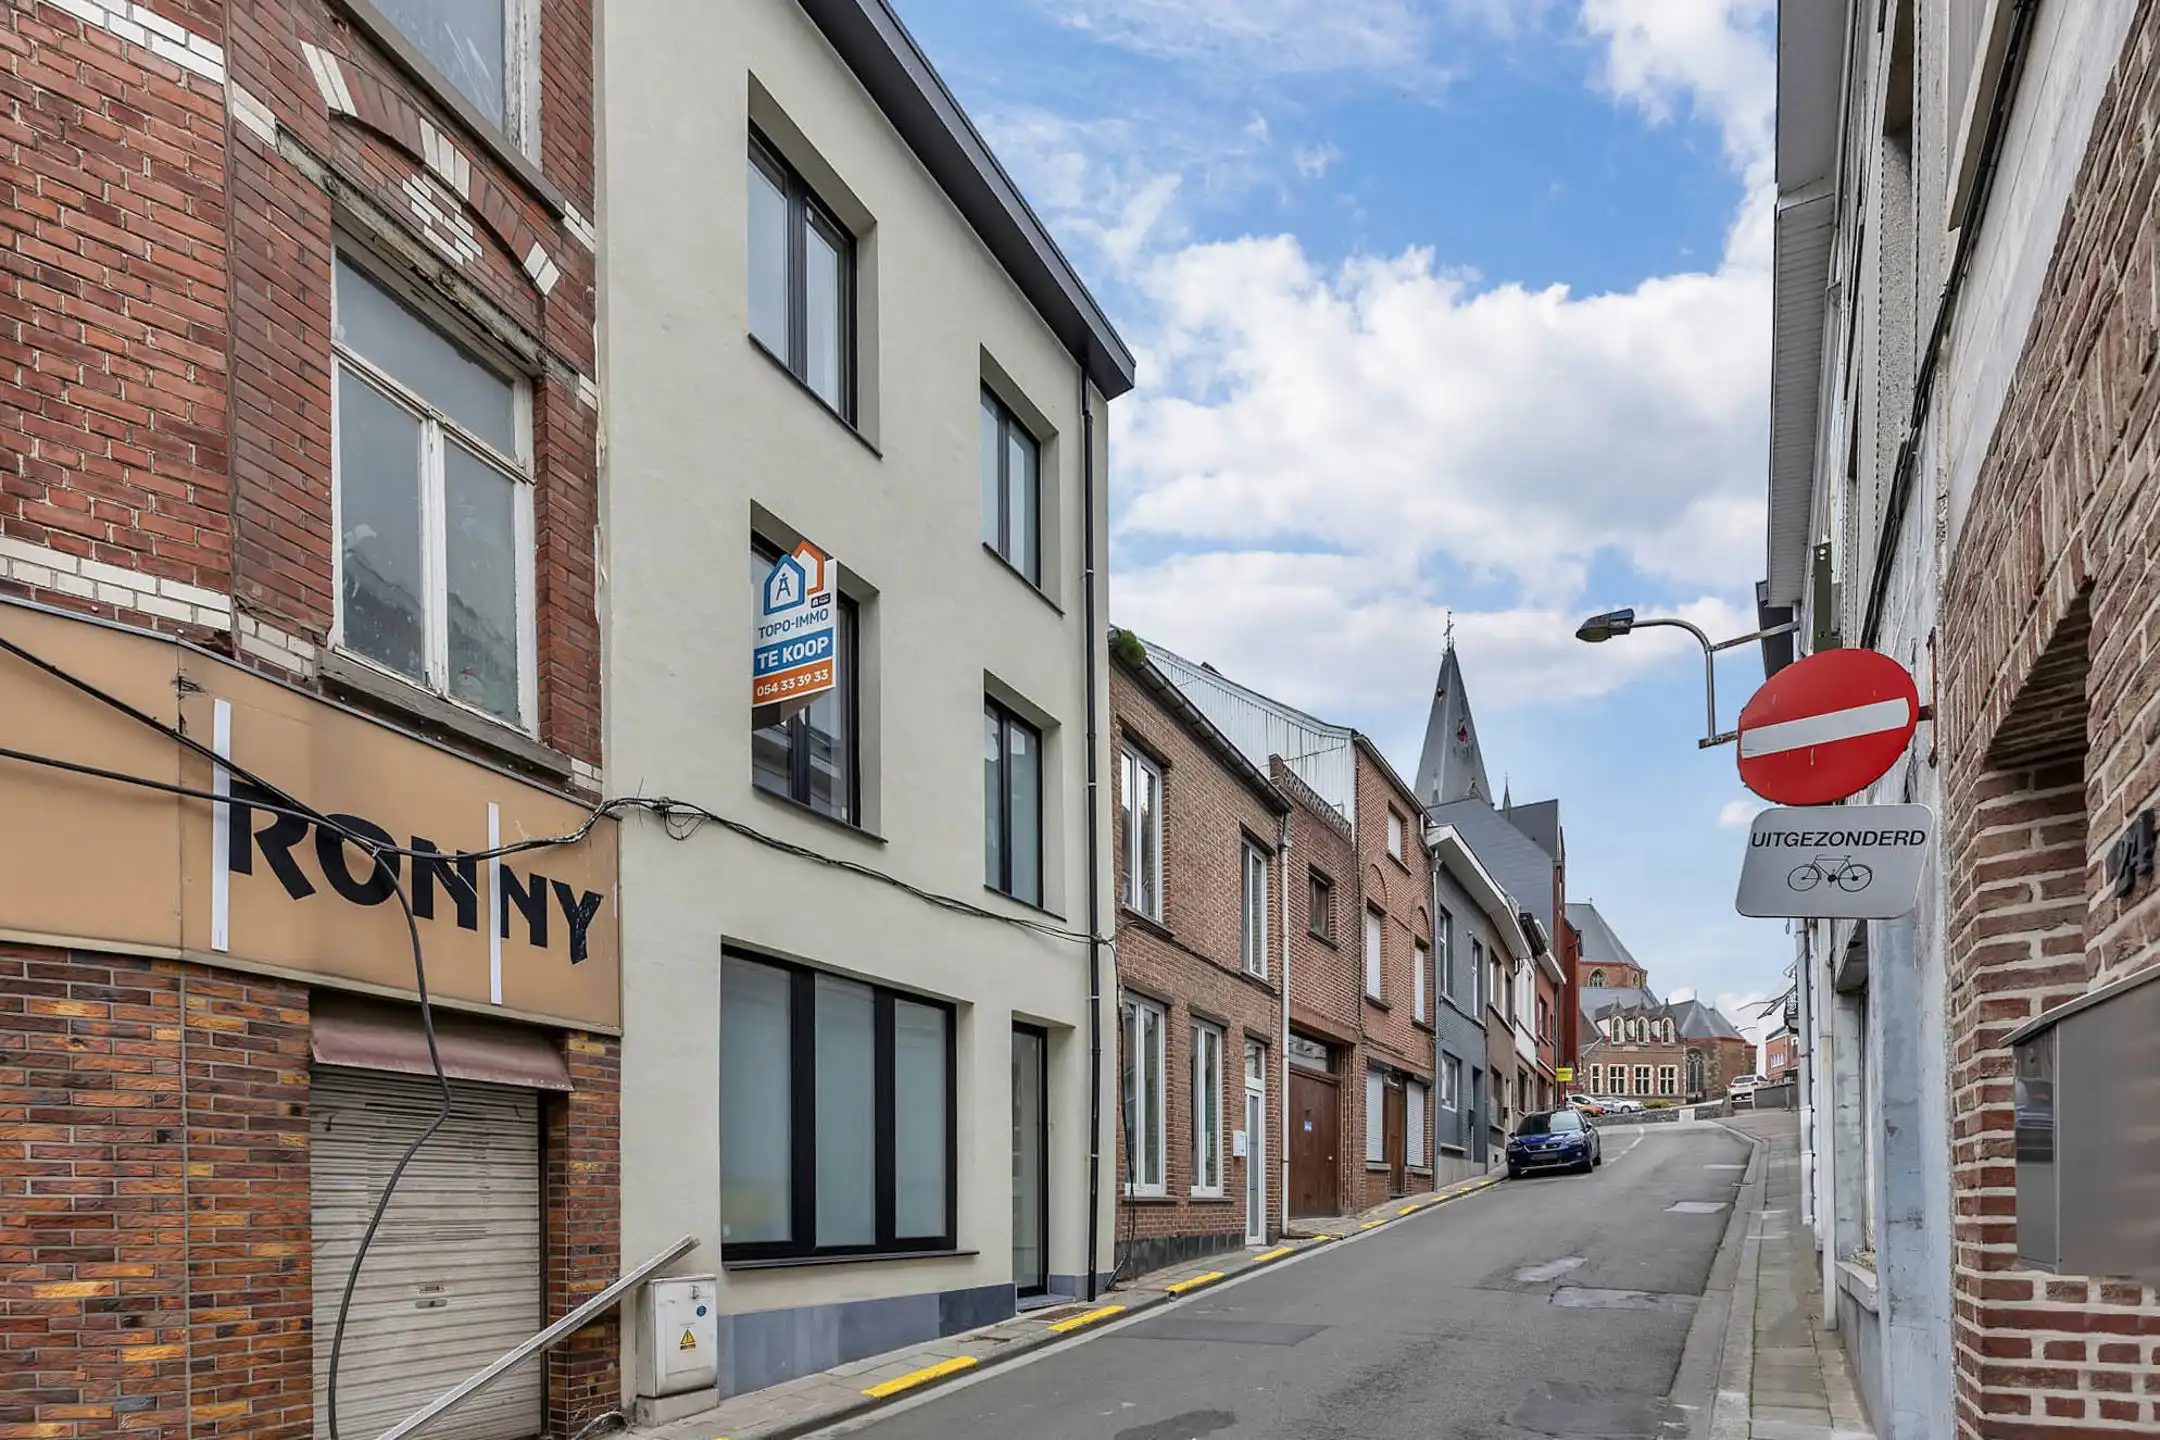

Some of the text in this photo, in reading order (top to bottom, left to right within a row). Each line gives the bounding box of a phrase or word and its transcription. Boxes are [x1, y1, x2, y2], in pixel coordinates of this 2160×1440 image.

[758, 608, 829, 639] TOPO-IMMO
[757, 636, 829, 670] TE KOOP
[756, 668, 829, 697] 054 33 39 33
[1751, 830, 1926, 848] UITGEZONDERD
[228, 778, 603, 965] RONNY
